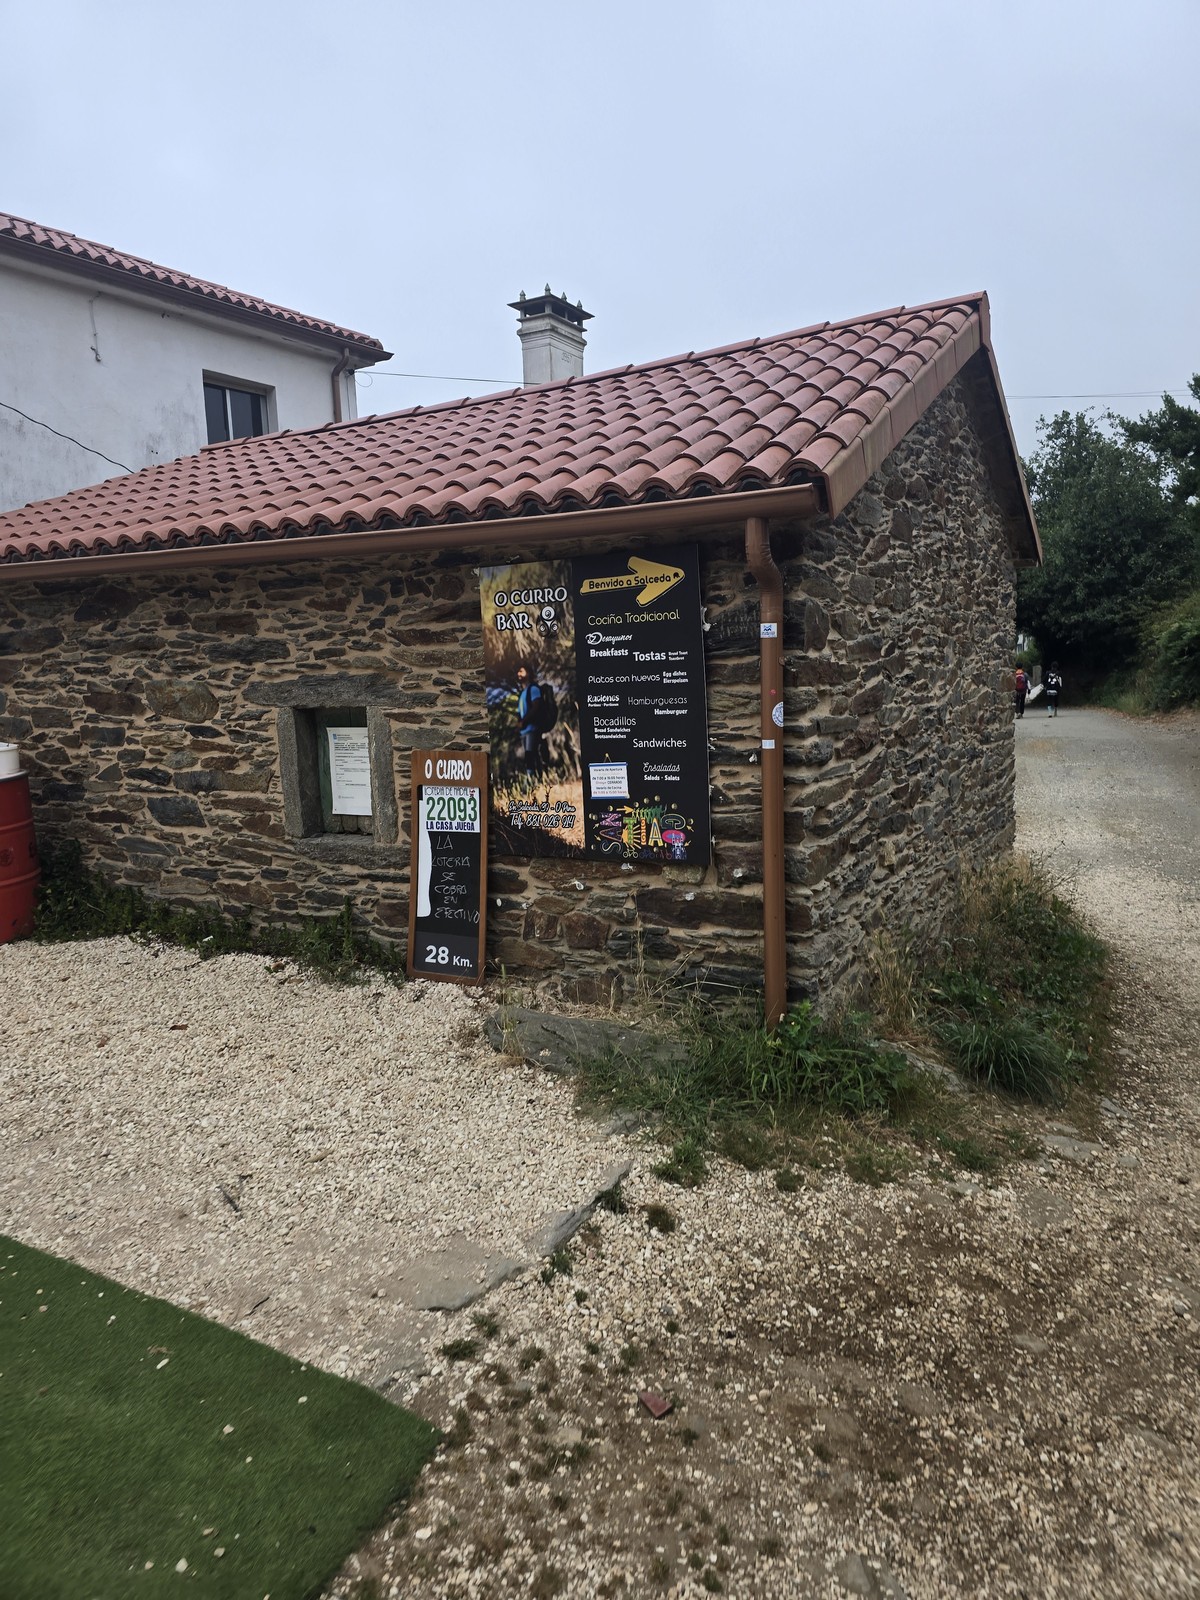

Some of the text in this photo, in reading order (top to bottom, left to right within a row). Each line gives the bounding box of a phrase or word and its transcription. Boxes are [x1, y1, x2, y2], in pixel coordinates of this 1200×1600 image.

[588, 574, 671, 590] Benvido a Salceda
[495, 587, 568, 607] O CURRO
[495, 612, 532, 631] BAR
[587, 609, 680, 626] Cociña Tradicional
[590, 648, 629, 658] Breakfasts
[632, 651, 667, 661] Tostas
[588, 675, 614, 684] Platos
[631, 673, 661, 682] huevos
[587, 694, 620, 703] Raciones
[627, 696, 688, 706] Hamburguesas
[593, 716, 637, 727] Bocadillos
[632, 738, 687, 748] Sandwiches
[425, 759, 473, 780] O CURRO
[643, 761, 681, 773] Ensaladas
[426, 796, 478, 822] 22093
[426, 821, 475, 831] LA CASA JUEGA
[436, 834, 454, 850] LA
[434, 884, 467, 895] COBRA
[434, 906, 480, 924] EFECTIVO
[425, 944, 473, 968] 28 Km.
